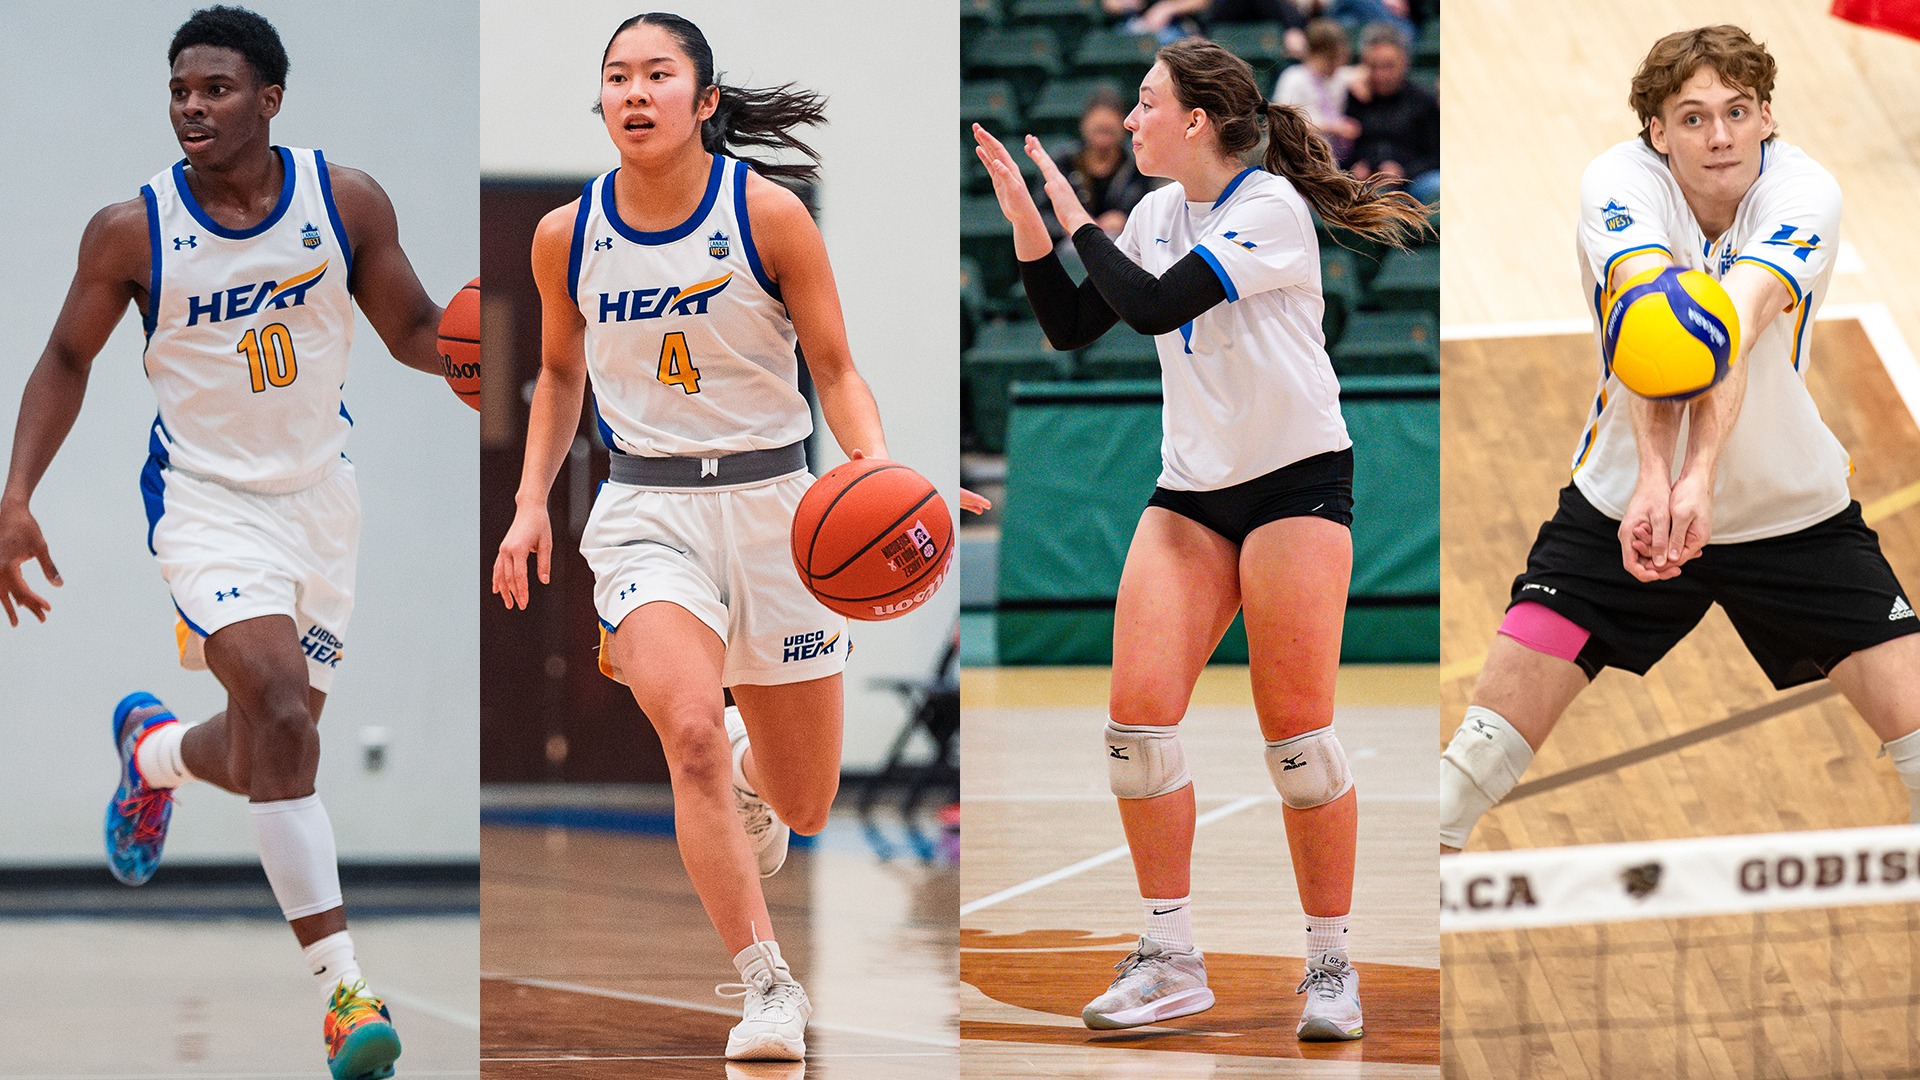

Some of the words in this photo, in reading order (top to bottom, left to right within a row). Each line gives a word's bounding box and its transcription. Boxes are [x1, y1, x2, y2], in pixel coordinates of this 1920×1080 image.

[1607, 215, 1631, 230] WEST
[710, 247, 728, 255] WEST
[186, 258, 330, 327] HEAT
[598, 271, 734, 323] HEAT
[237, 323, 298, 393] 10
[656, 331, 701, 395] 4
[308, 624, 343, 648] UBCO
[783, 630, 840, 663] HEAT
[784, 630, 824, 647] UBCO
[1739, 850, 1920, 893] GOBIS
